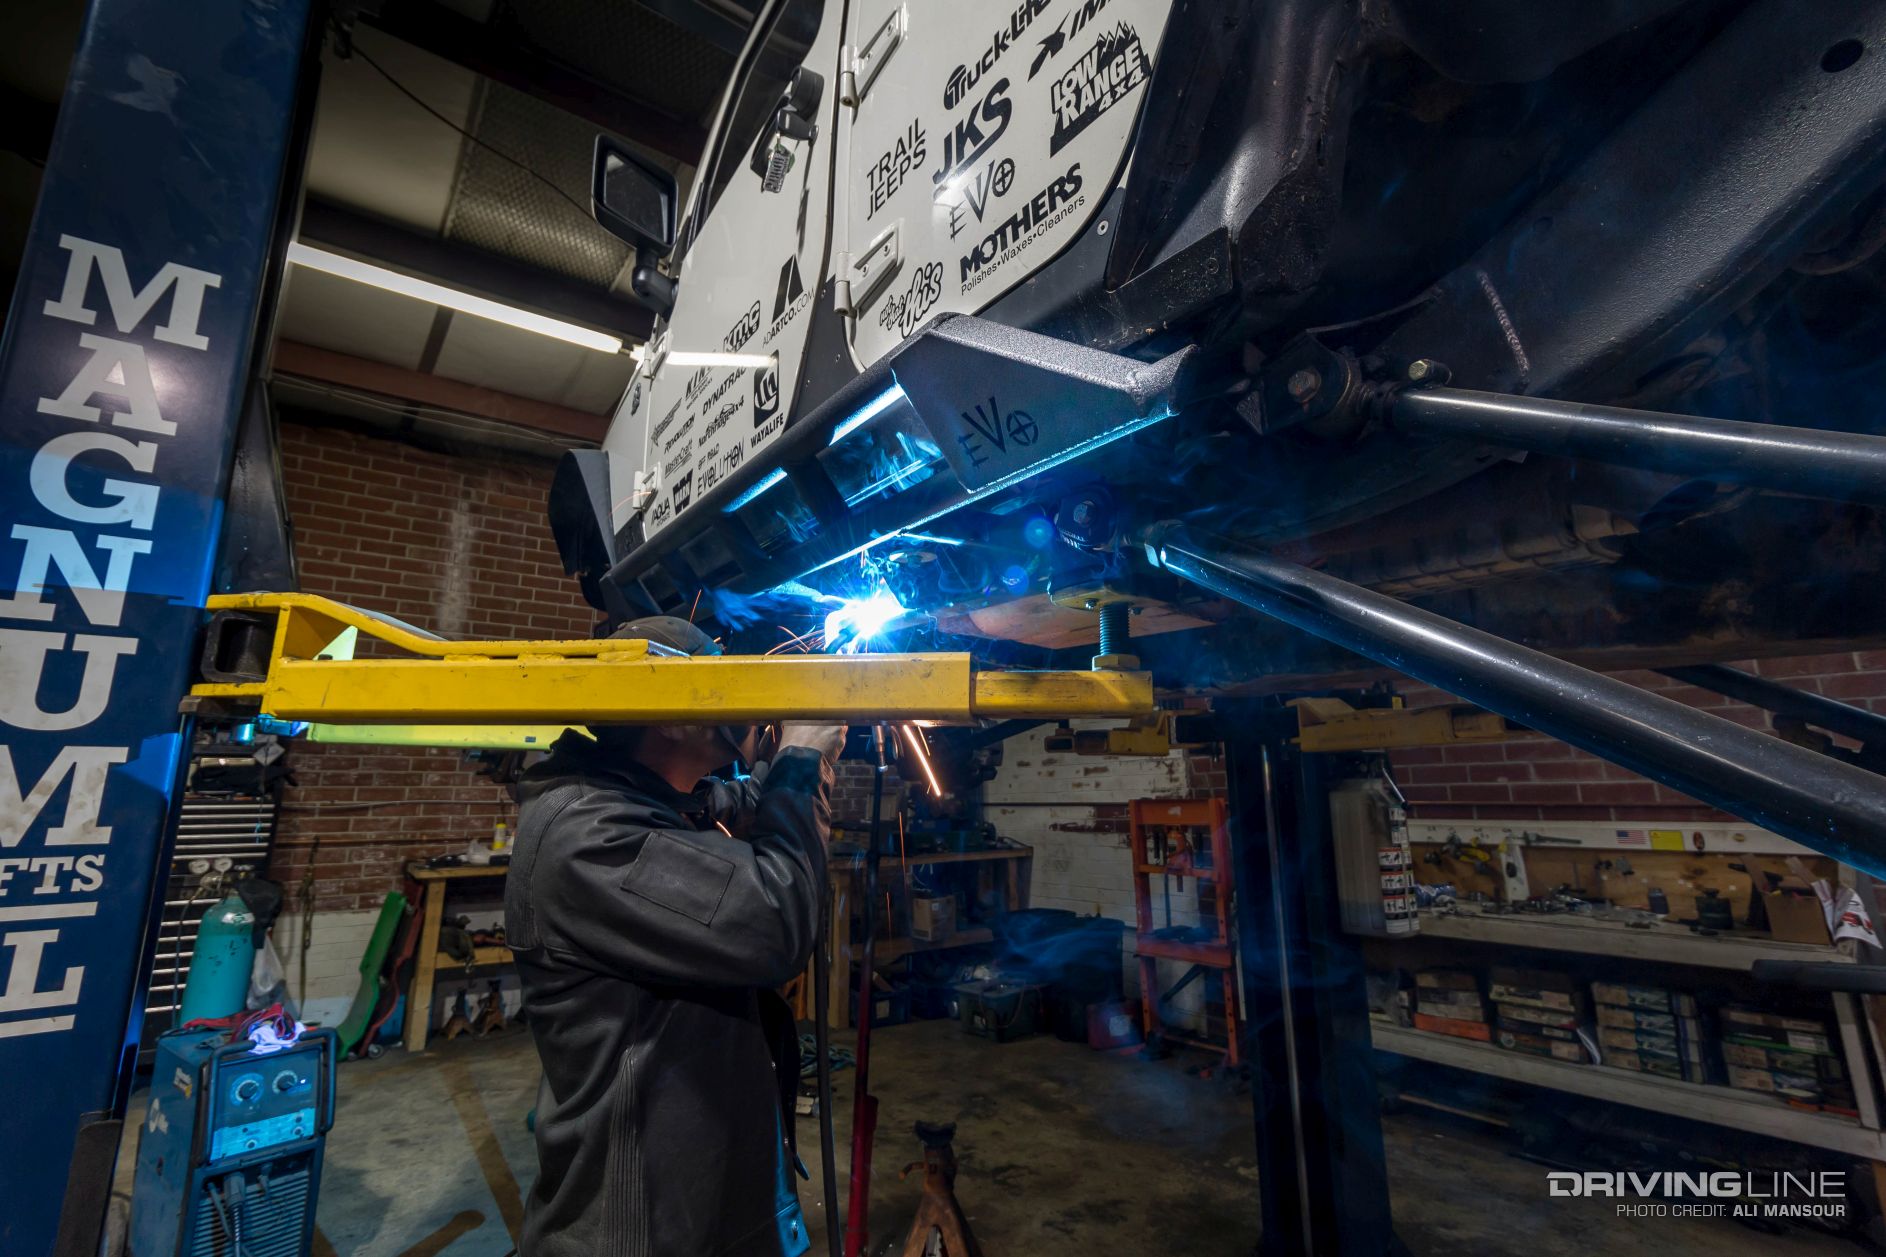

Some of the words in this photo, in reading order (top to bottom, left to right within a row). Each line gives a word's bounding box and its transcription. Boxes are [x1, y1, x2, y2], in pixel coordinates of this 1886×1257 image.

[1052, 43, 1099, 114] LOW
[1060, 39, 1141, 130] RANGE
[867, 117, 926, 192] TRAIL
[932, 77, 1012, 185] JKS
[867, 138, 926, 221] JEEPS
[960, 162, 1083, 284] MOTHERS
[751, 412, 784, 448] WAYALIFE
